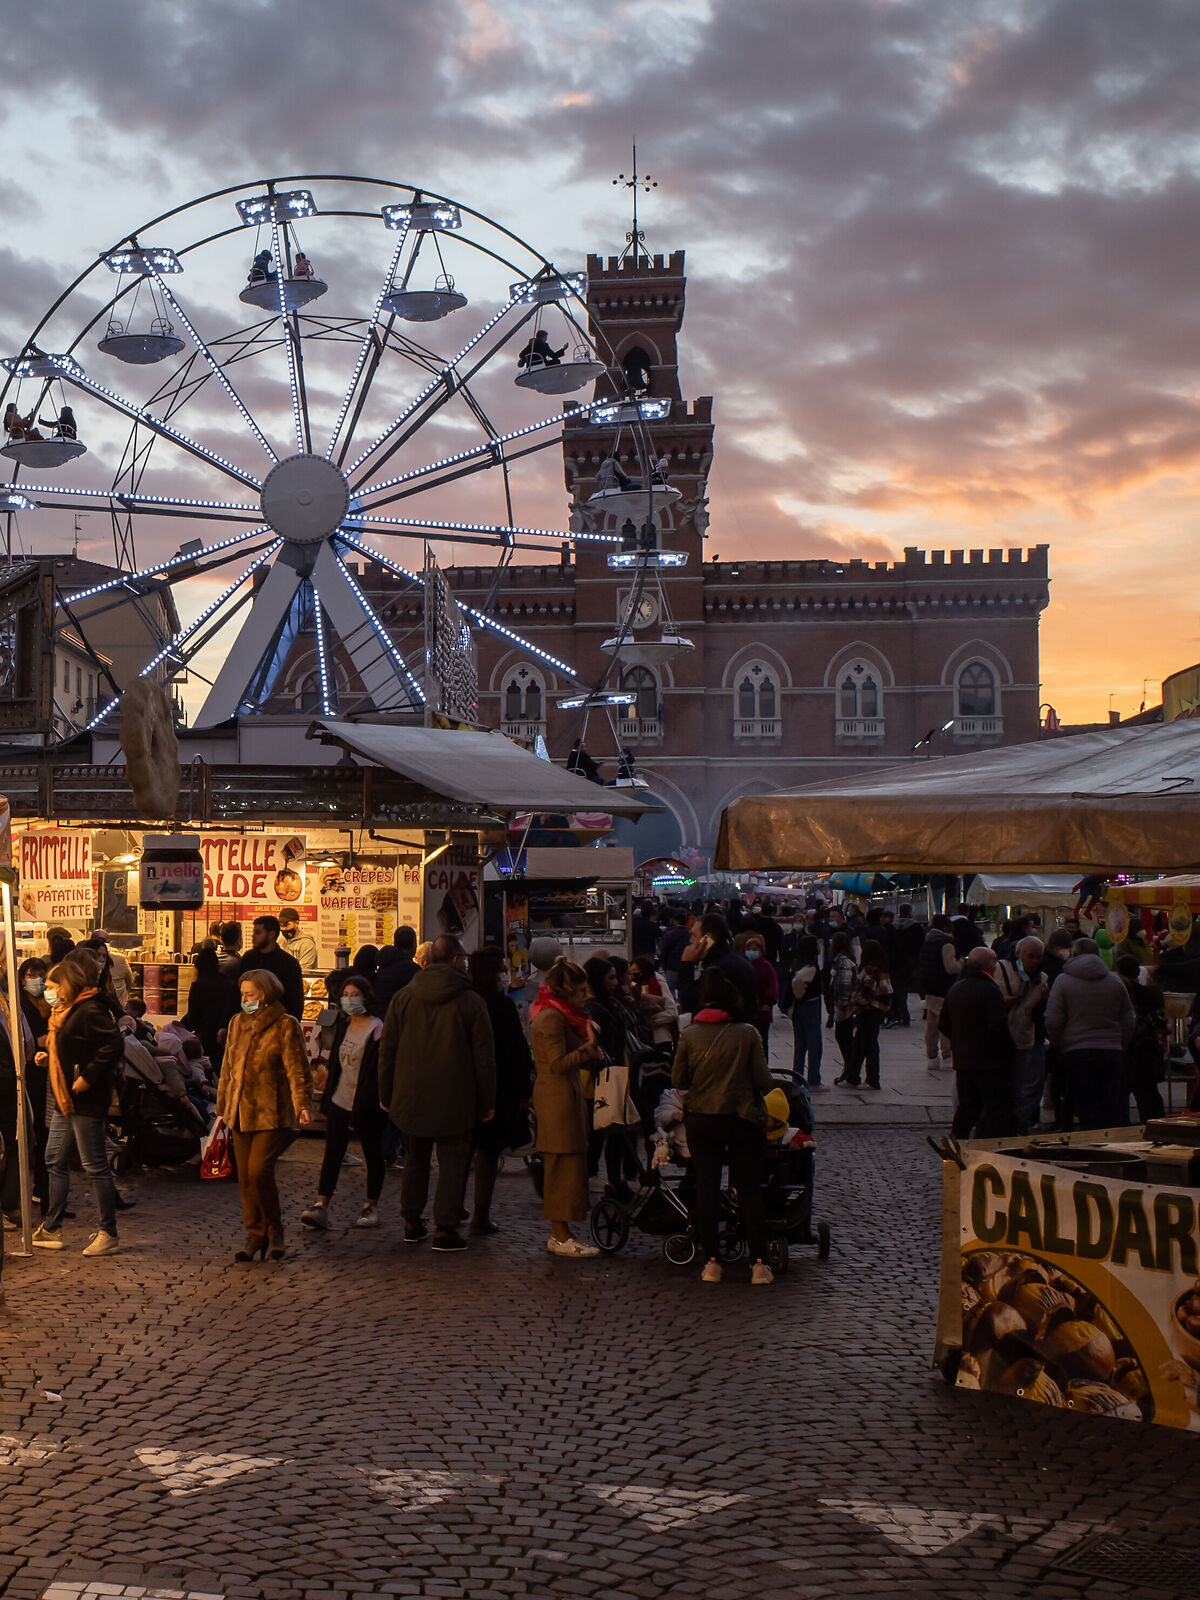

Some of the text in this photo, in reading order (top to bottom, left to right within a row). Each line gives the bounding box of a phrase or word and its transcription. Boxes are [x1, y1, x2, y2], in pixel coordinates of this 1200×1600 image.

[22, 835, 90, 880] FRITTELLE
[201, 838, 277, 872] TTELLE
[344, 869, 392, 883] CRÊPES
[203, 874, 267, 898] ALDE
[353, 885, 360, 894] e
[37, 888, 91, 902] PATATINE
[320, 896, 369, 909] WAFFEL
[51, 904, 92, 917] FRITTE
[971, 1163, 1200, 1276] CALDAR
